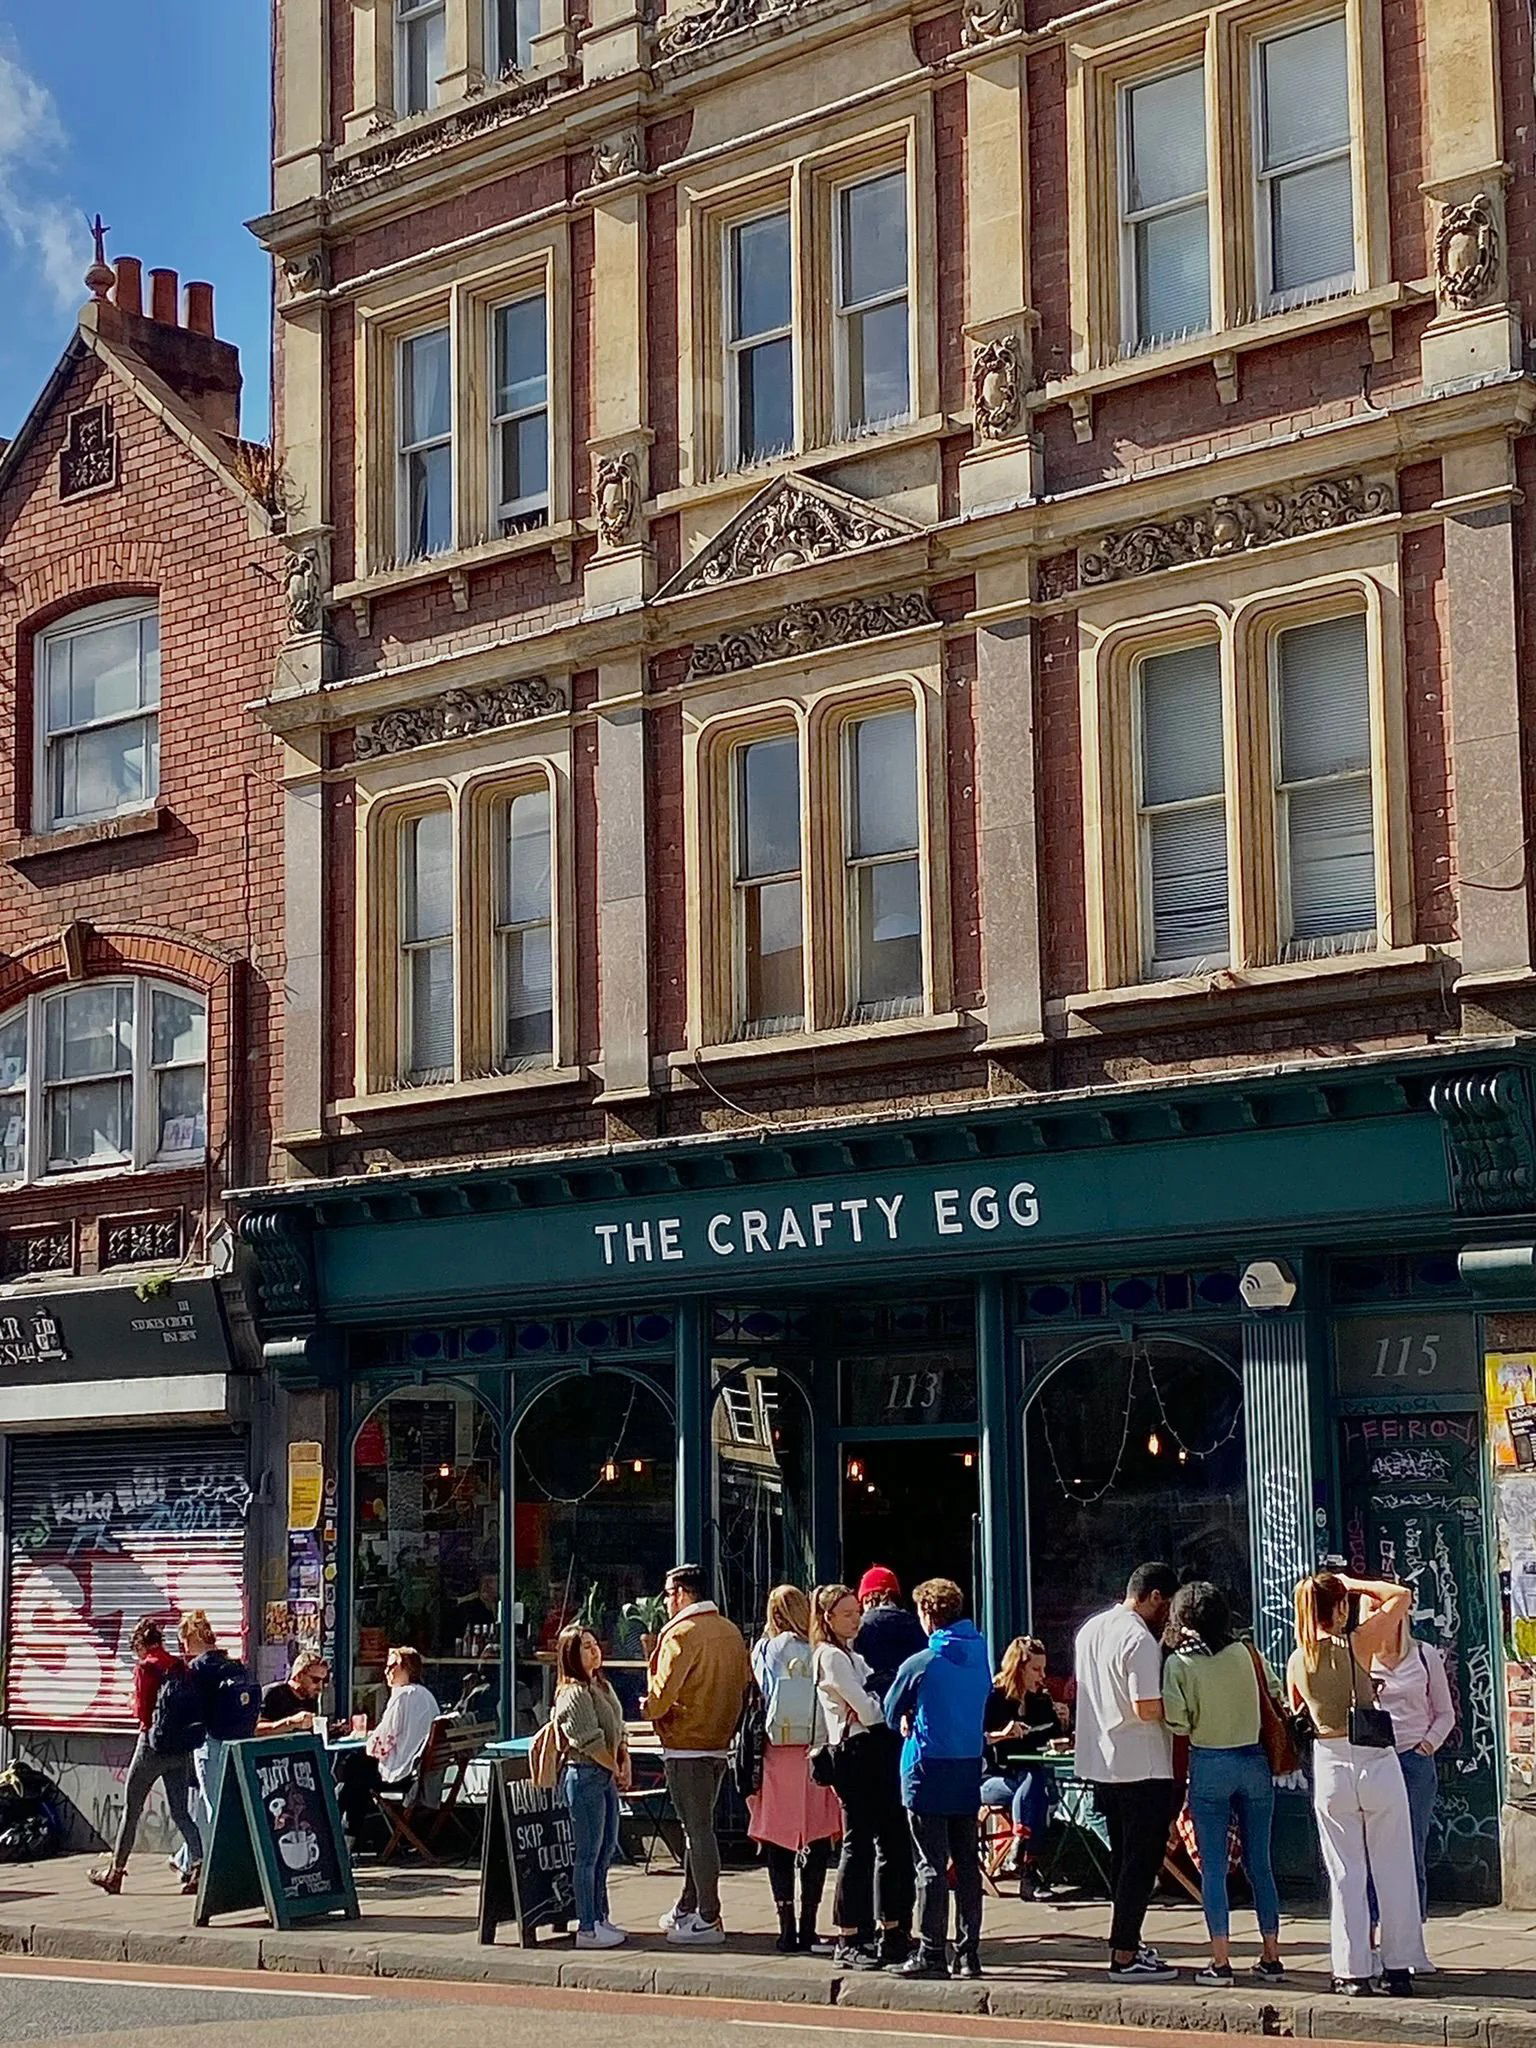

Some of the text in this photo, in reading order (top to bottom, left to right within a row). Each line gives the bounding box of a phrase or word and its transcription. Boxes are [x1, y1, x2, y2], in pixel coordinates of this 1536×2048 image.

[595, 1182, 1040, 1265] THE CRAFTY EGG
[131, 1314, 194, 1331] STOKES CROFT
[1371, 1335, 1441, 1378] 115
[885, 1373, 938, 1409] 113
[516, 1822, 544, 1850] SKIP
